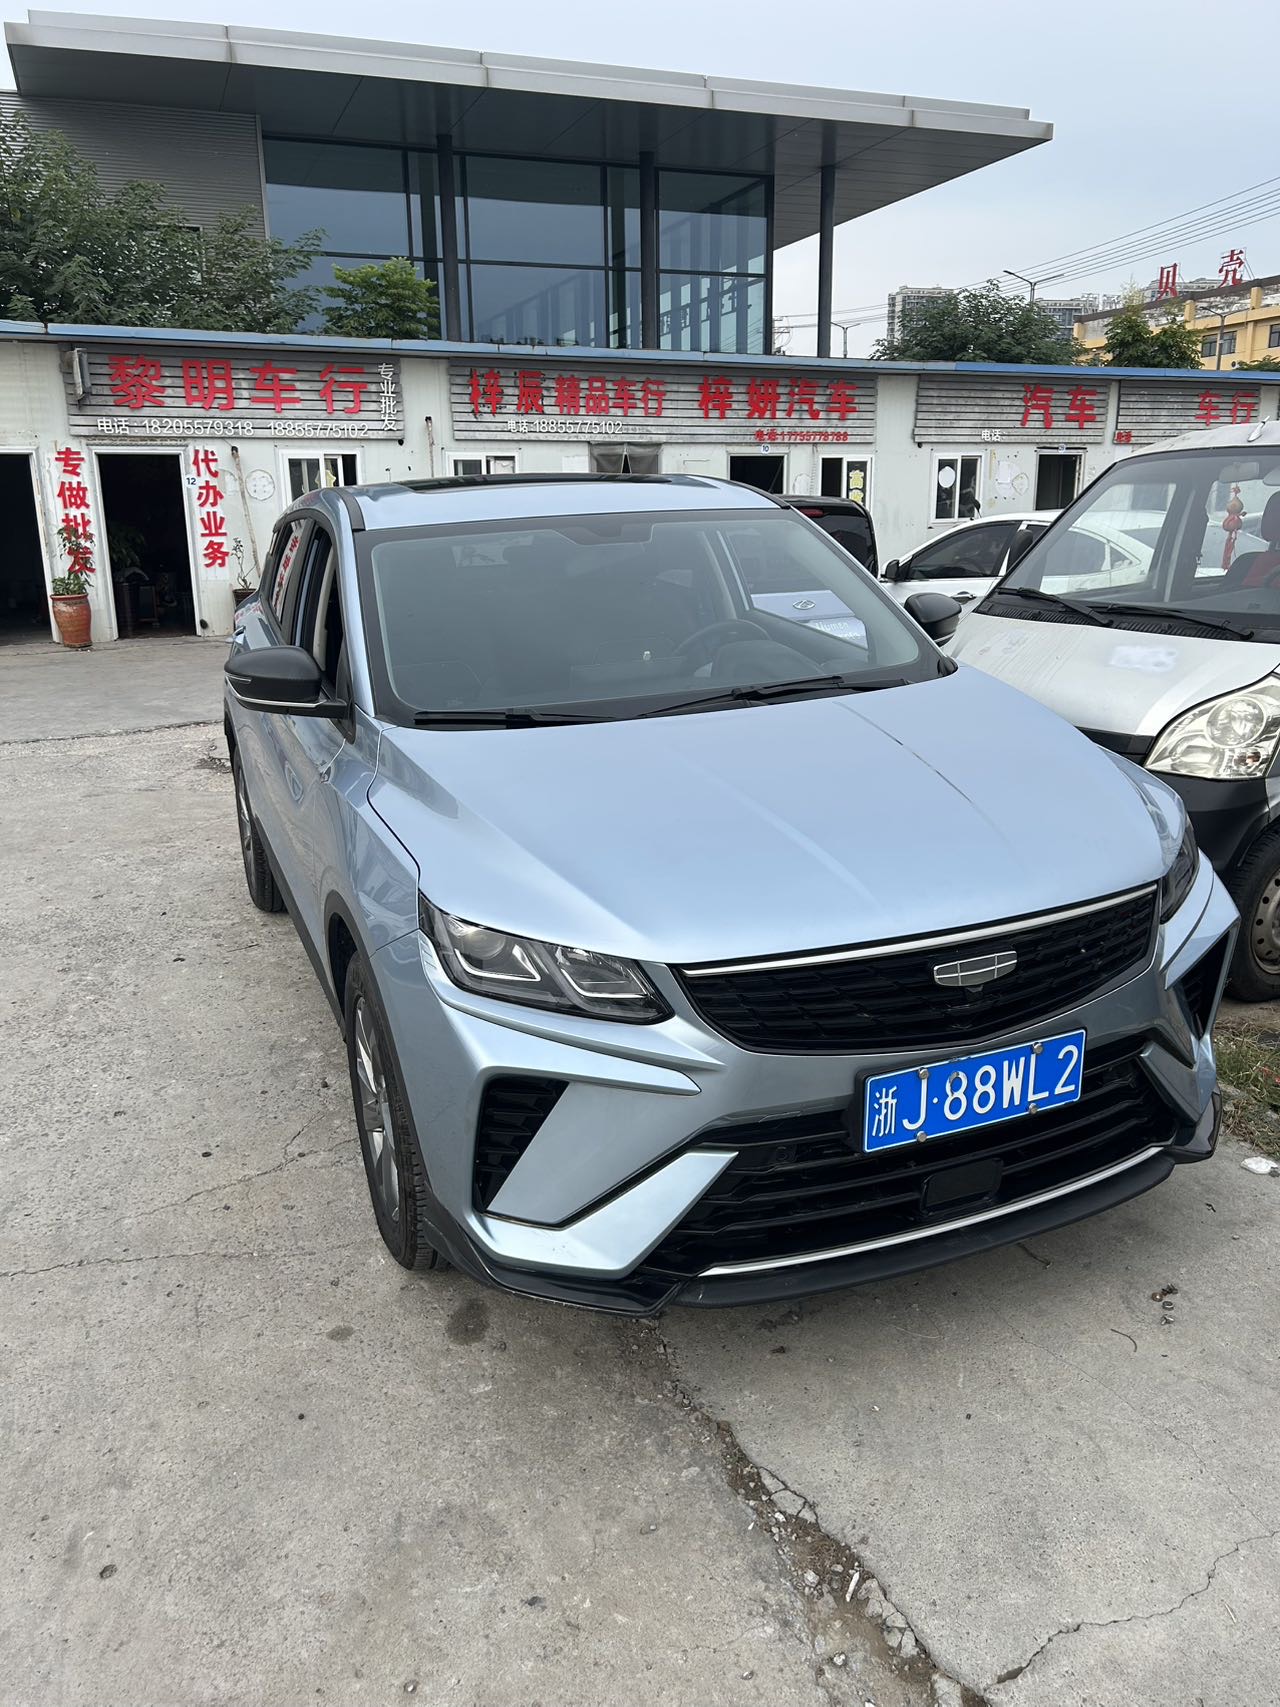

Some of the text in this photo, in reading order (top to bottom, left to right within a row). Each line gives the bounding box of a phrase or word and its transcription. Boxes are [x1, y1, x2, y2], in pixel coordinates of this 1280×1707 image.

[1157, 249, 1245, 301] 贝壳
[108, 355, 368, 414] 黎明车行
[377, 362, 397, 431] 专业批发
[698, 375, 859, 421] 梓妍汽车
[1020, 384, 1098, 429] 汽车
[1195, 389, 1256, 426] 车行
[267, 421, 369, 438] 18855775102
[186, 477, 197, 485] 12
[55, 447, 96, 574] 专做批发
[192, 449, 230, 568] 代办业务
